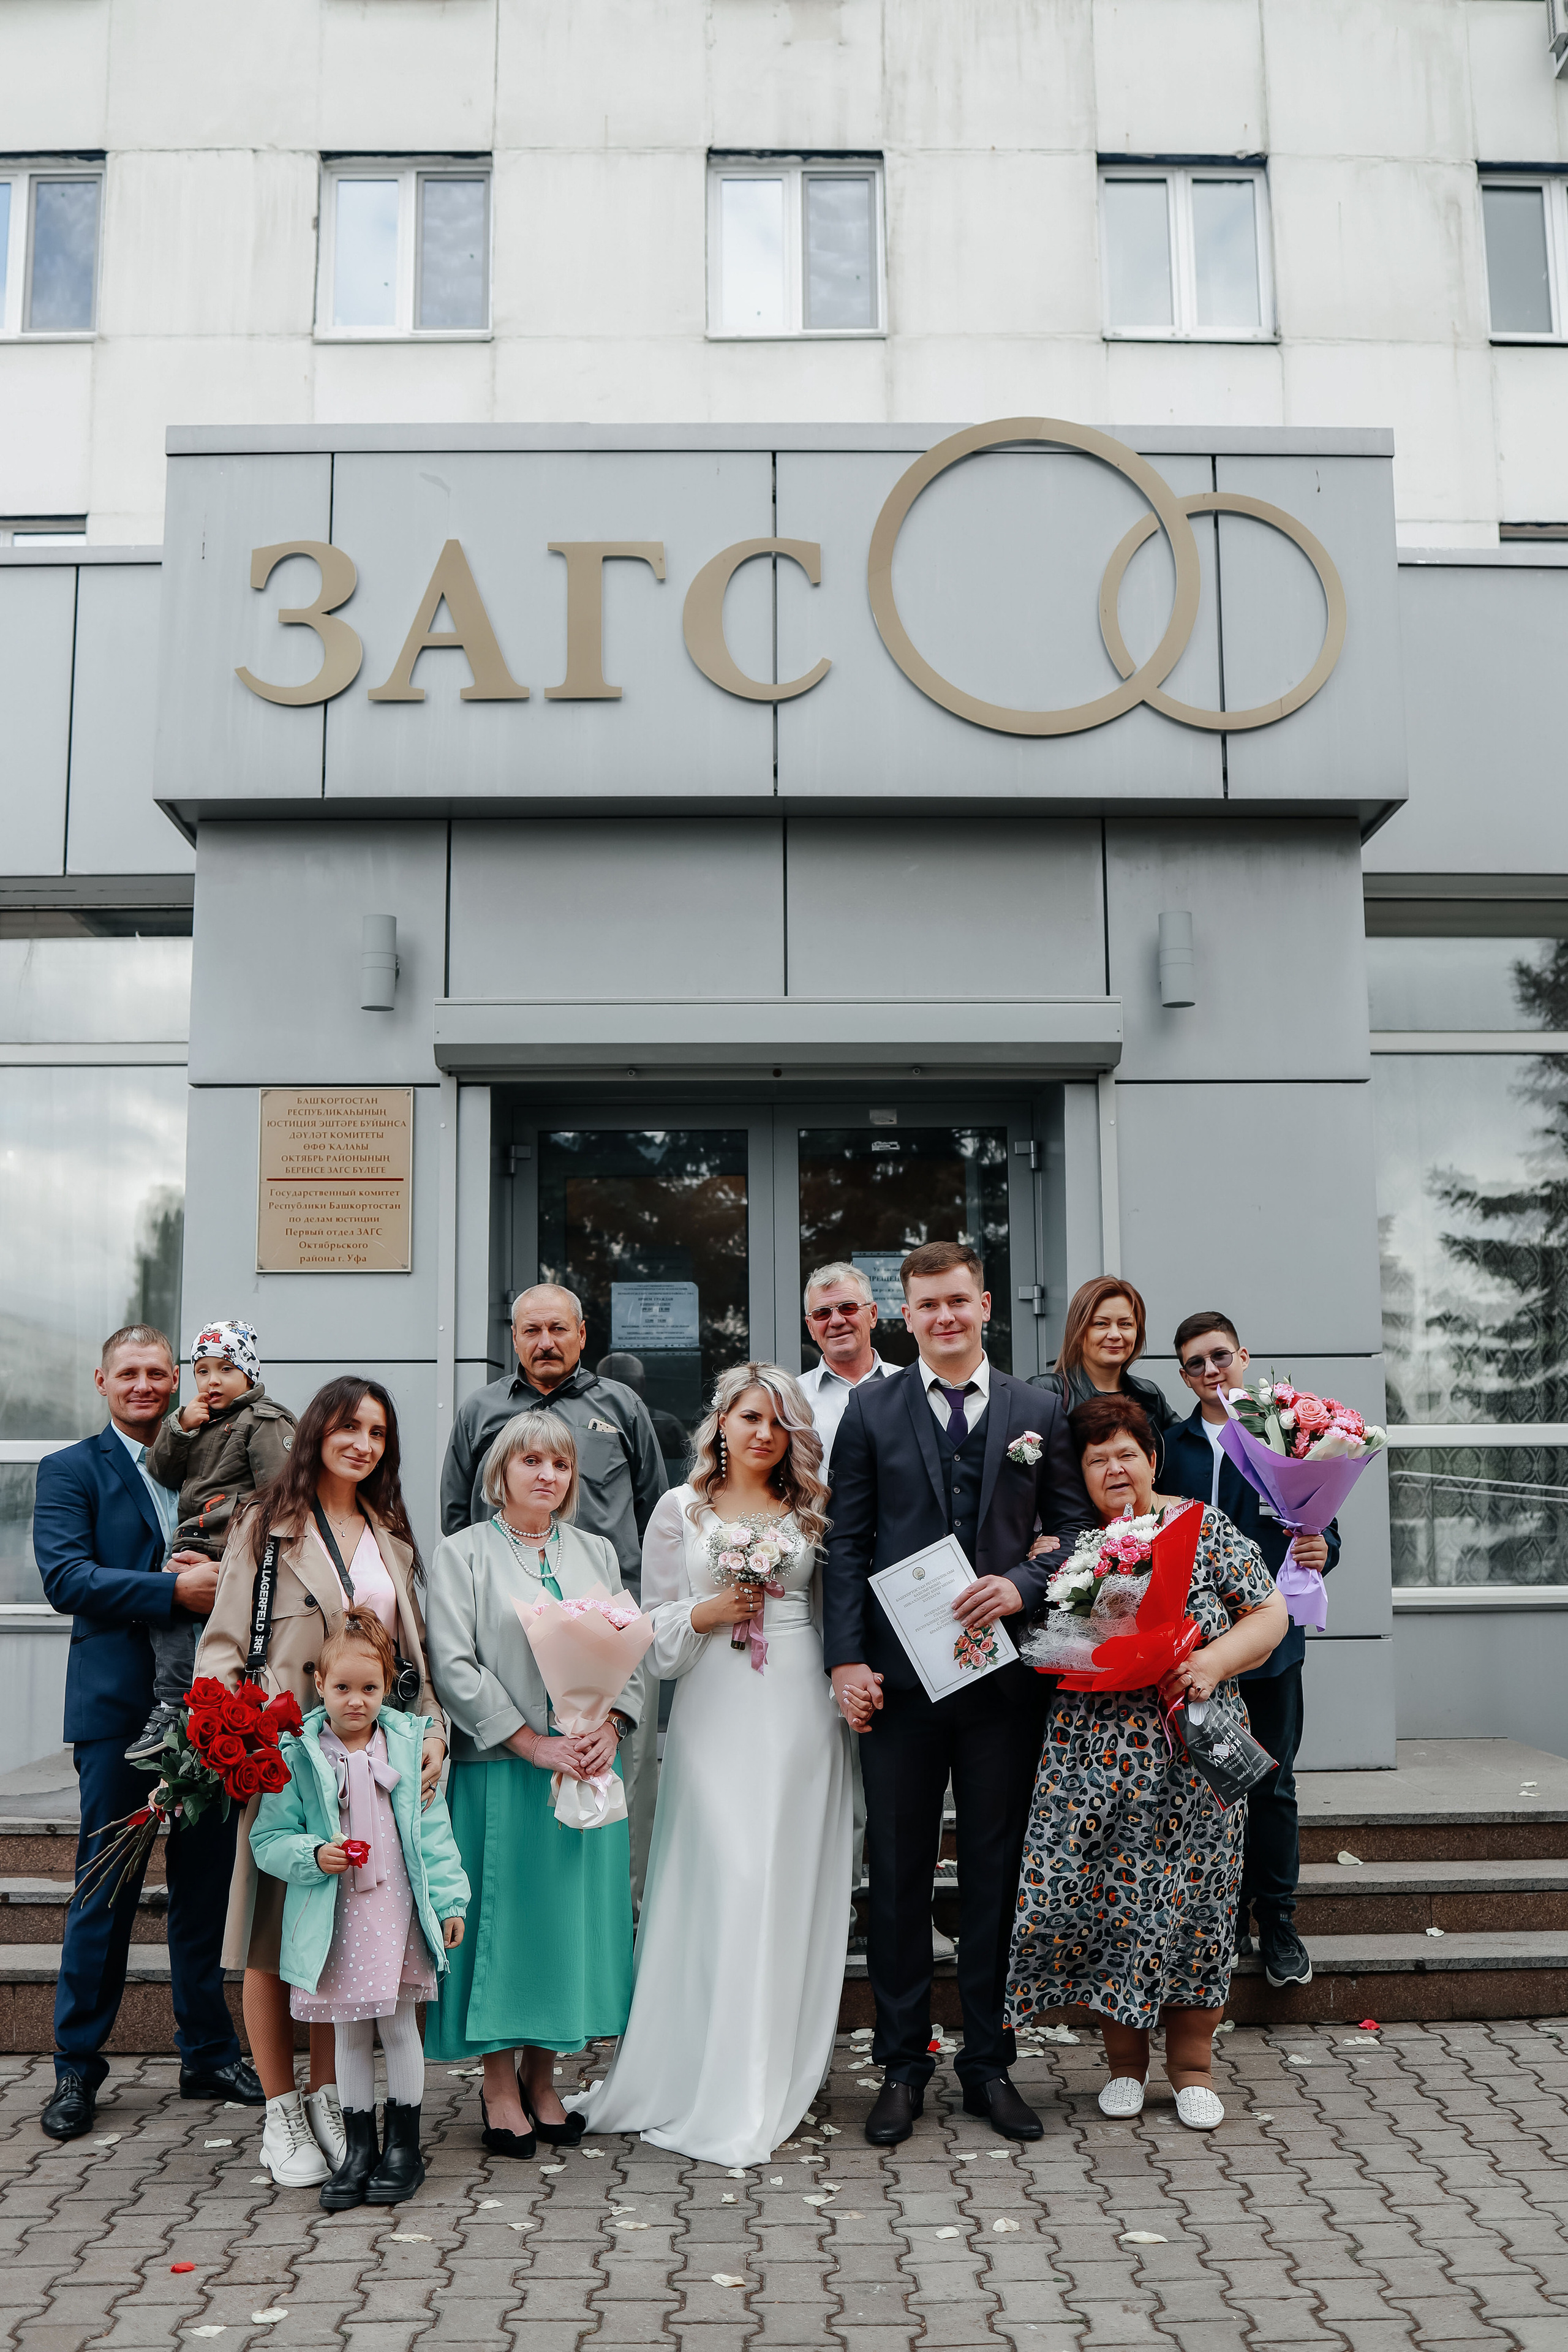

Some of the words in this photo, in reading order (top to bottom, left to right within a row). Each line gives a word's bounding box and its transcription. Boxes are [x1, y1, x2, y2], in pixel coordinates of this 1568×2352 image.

[234, 537, 833, 706] ЗАГС
[360, 1118, 407, 1127] БУЙЫНСА
[270, 1188, 356, 1198] Государственный
[268, 1202, 326, 1212] Республики
[328, 1202, 401, 1211] Башкортостан
[285, 1227, 324, 1238] Первый
[356, 1227, 383, 1236] ЗАГС
[298, 1241, 369, 1251] Октябрьского
[300, 1255, 336, 1264] района
[347, 1254, 368, 1264] Уфа
[198, 1332, 222, 1345] M
[262, 1541, 275, 1569] KARL
[255, 1570, 271, 1632] LAGERFELD
